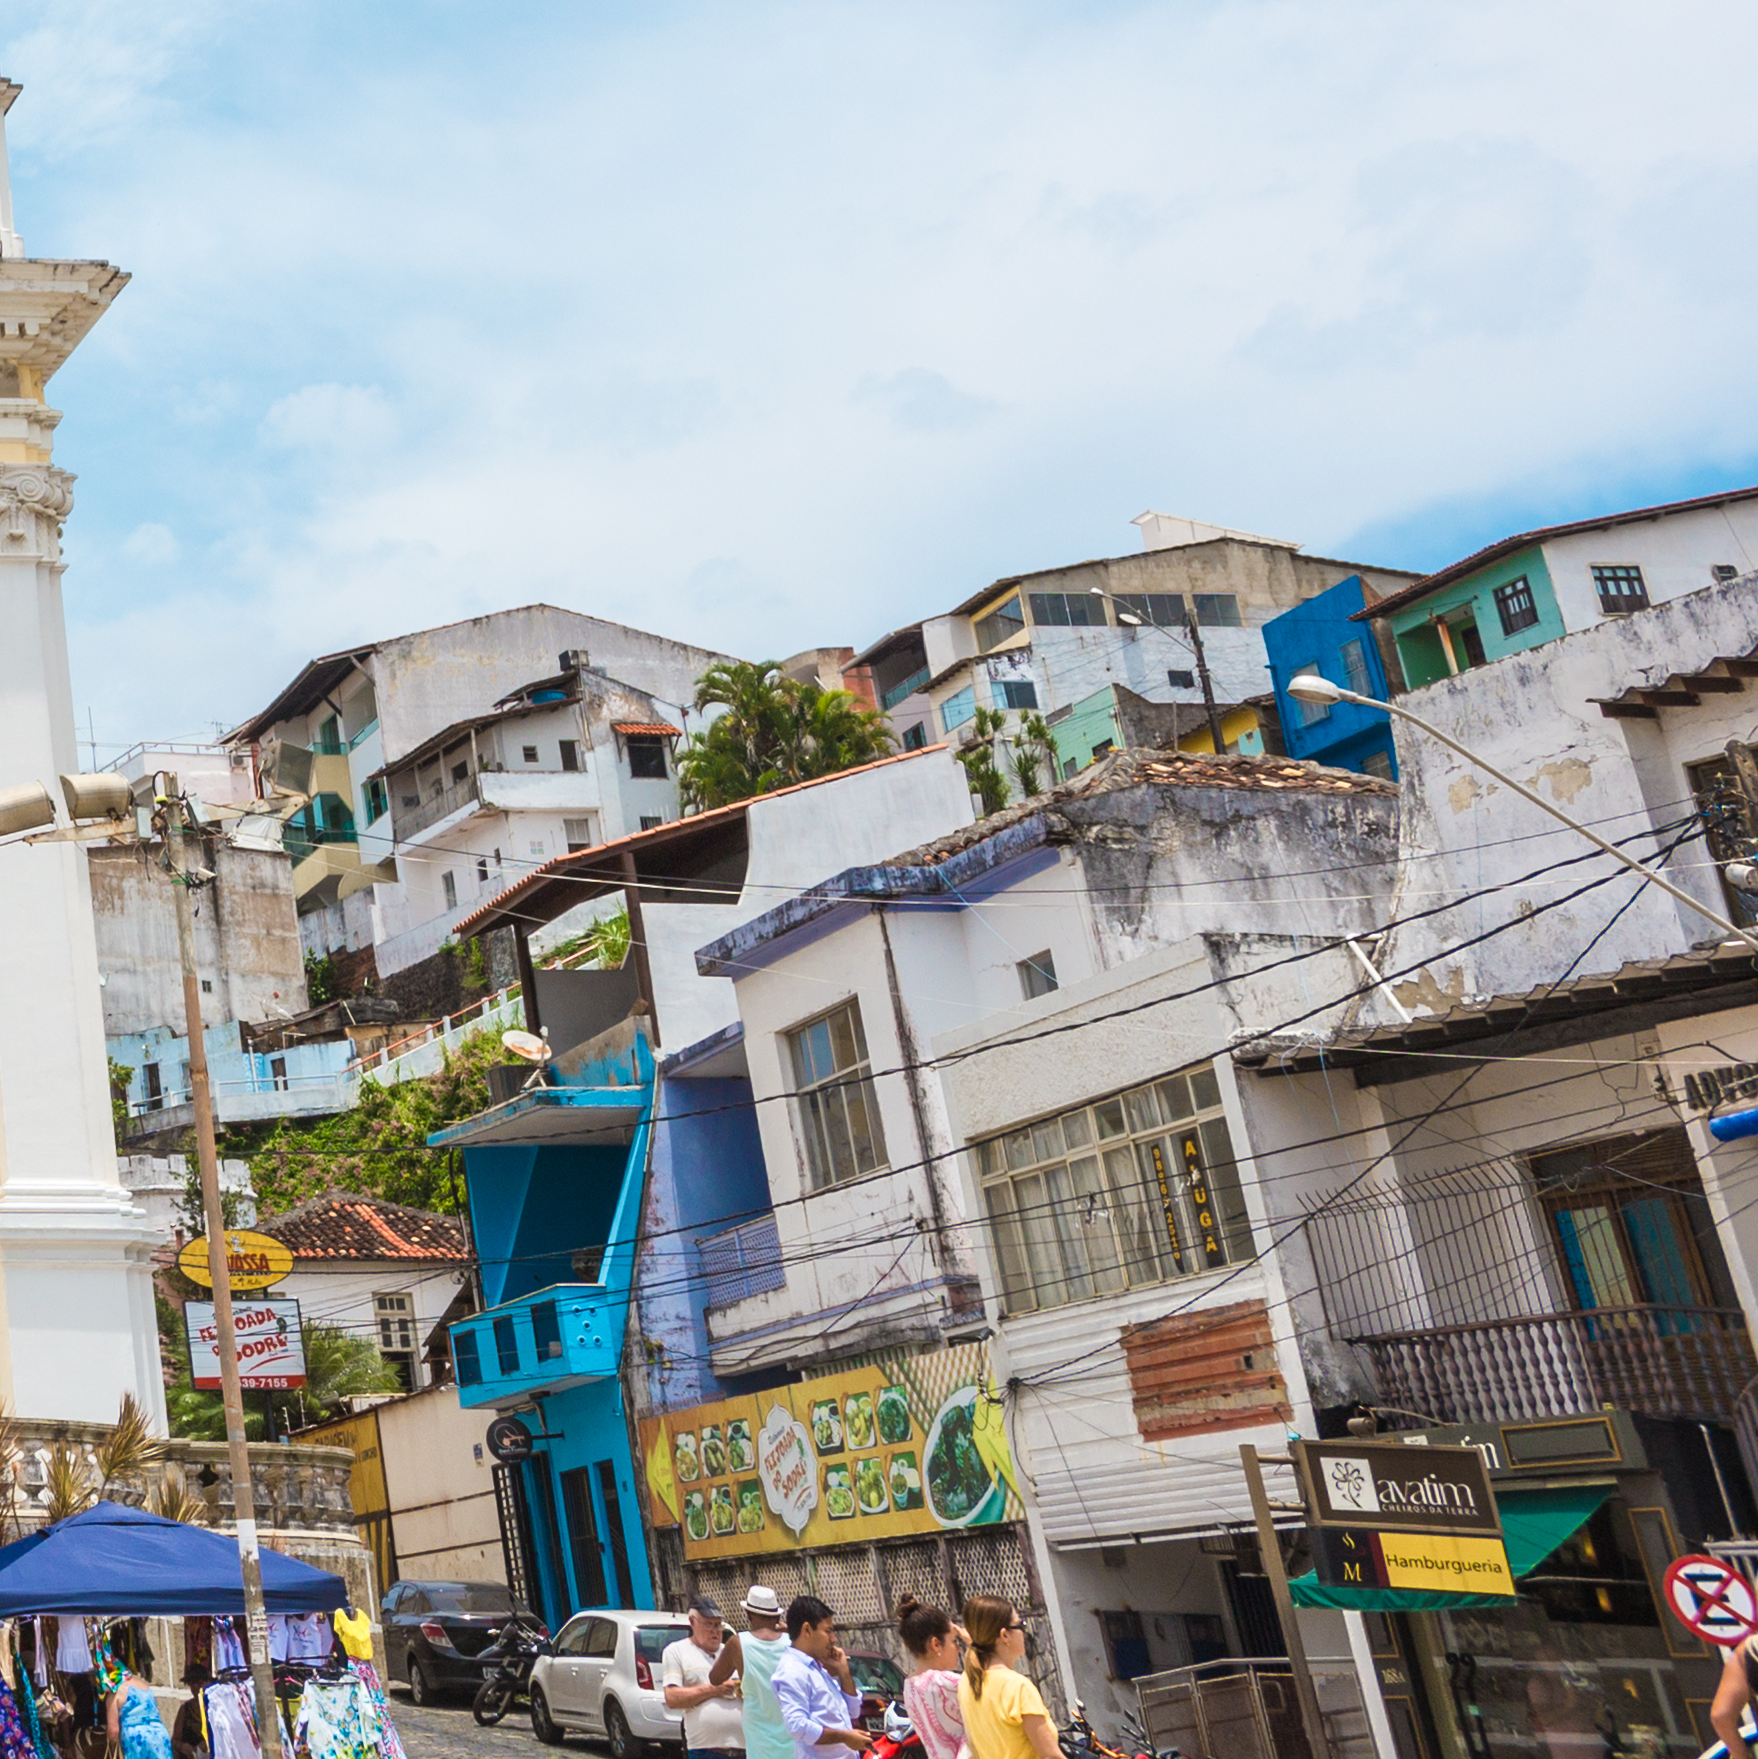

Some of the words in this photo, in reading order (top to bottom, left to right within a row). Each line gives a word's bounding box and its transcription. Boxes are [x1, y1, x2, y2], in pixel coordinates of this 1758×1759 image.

[1683, 1062, 1758, 1111] ADVO
[199, 1307, 278, 1342] FEOADA
[1377, 1473, 1475, 1508] avatim
[1382, 1504, 1426, 1514] CHEIROS
[1429, 1505, 1442, 1514] DA
[1446, 1506, 1479, 1516] TERRA
[1343, 1562, 1362, 1582] M
[1385, 1554, 1503, 1574] Hamburgueria
